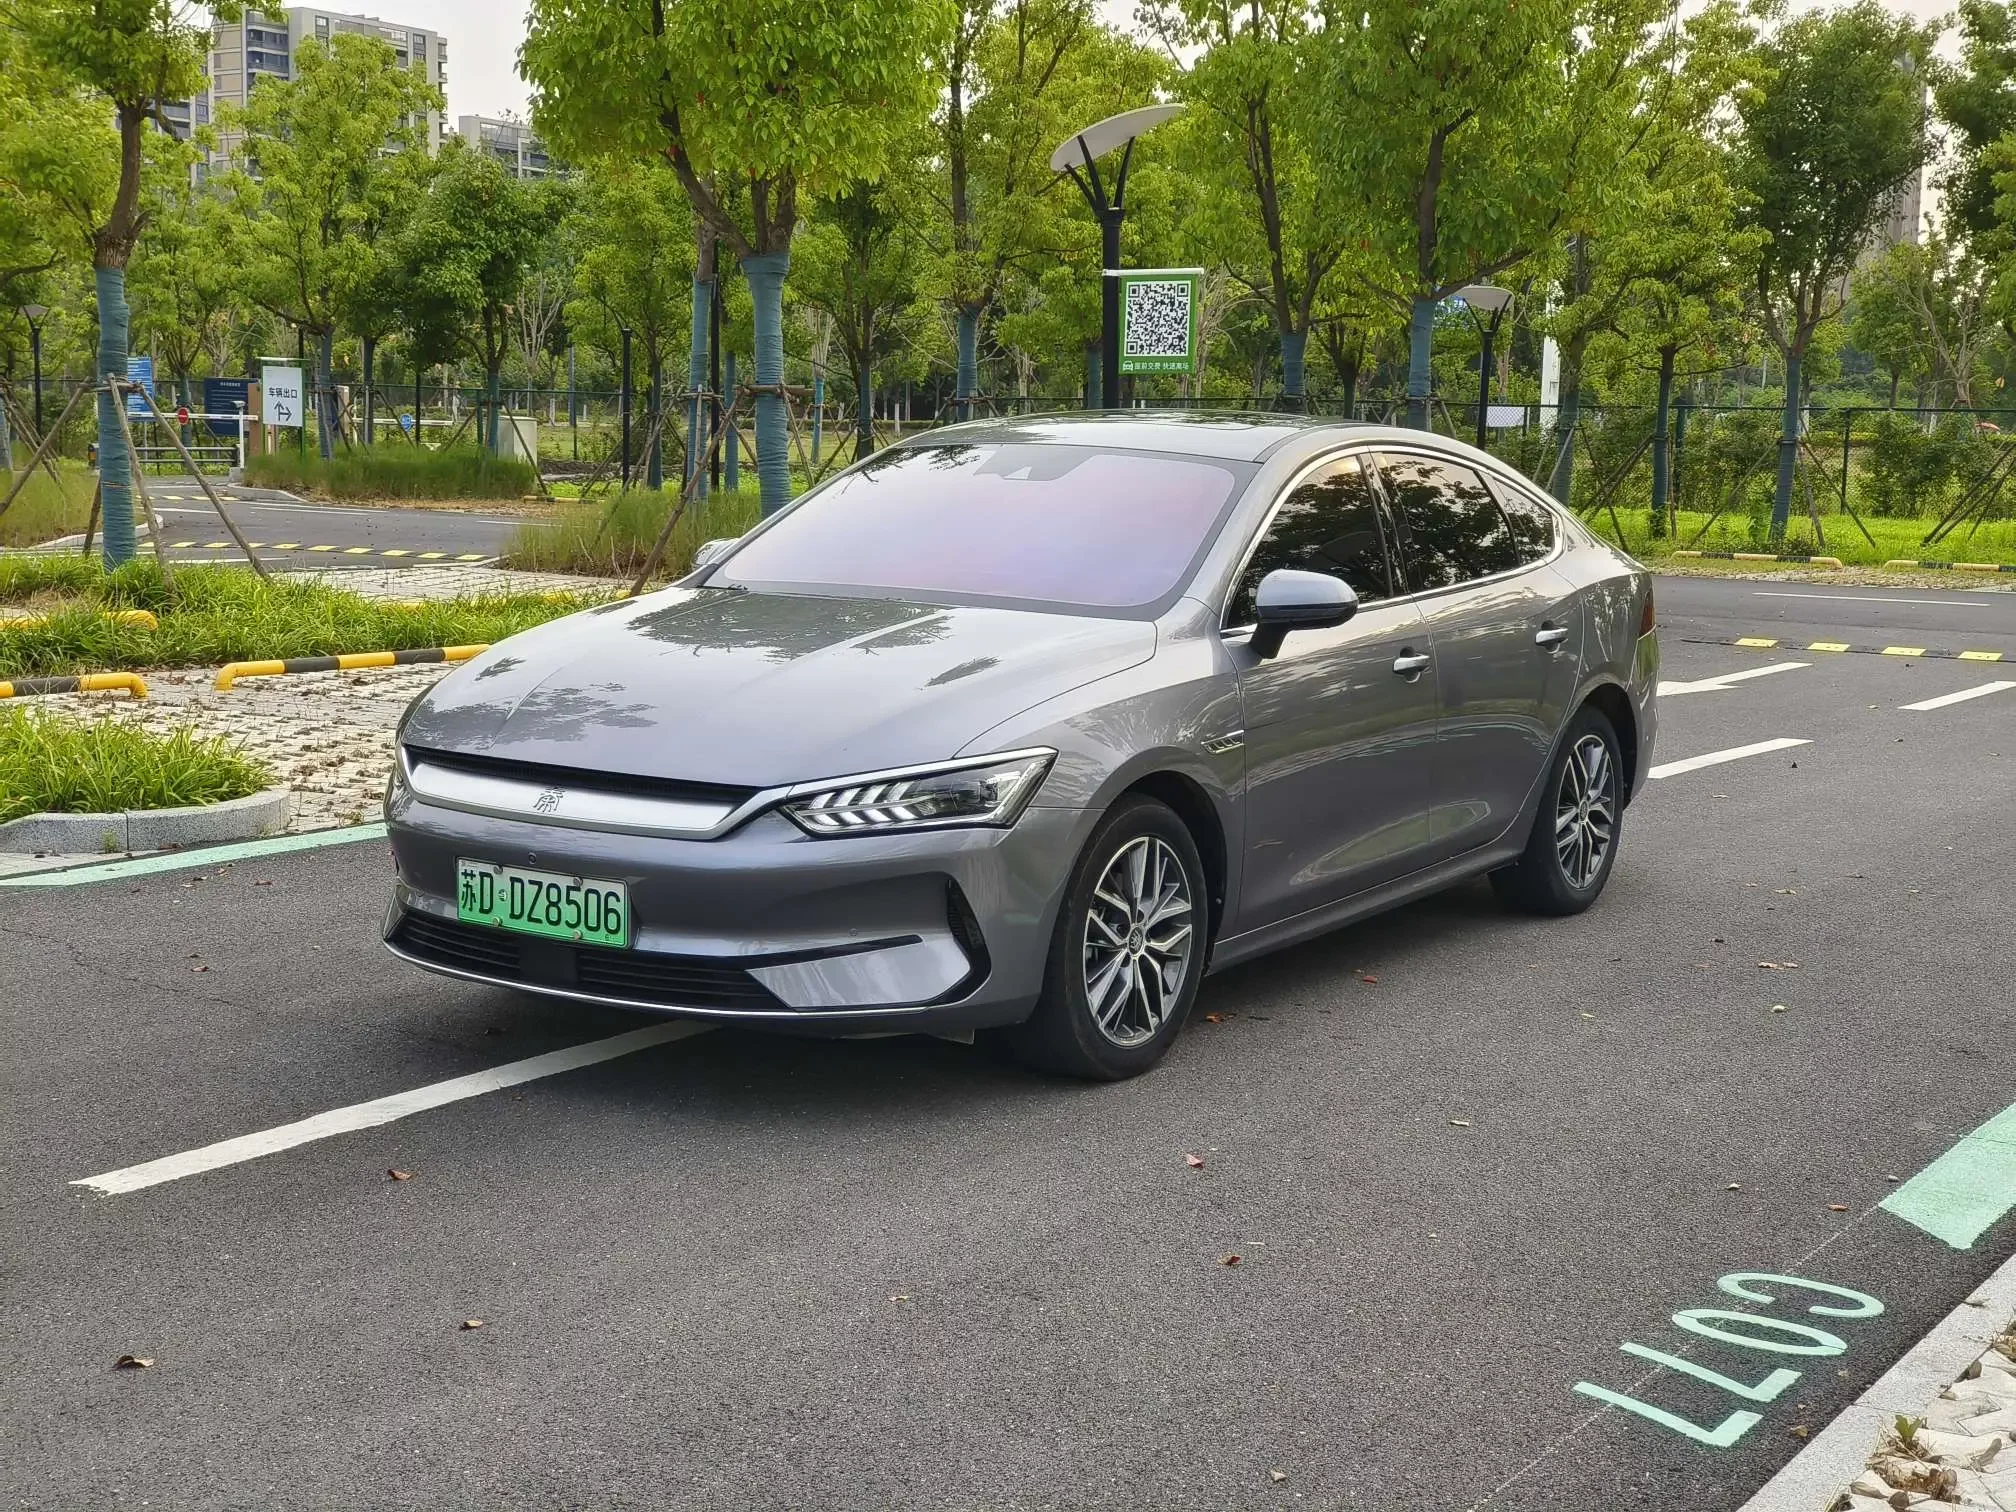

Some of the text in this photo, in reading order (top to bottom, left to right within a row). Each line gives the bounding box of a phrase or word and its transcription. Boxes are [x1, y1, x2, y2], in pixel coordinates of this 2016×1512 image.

[268, 387, 298, 399] 车辆出口
[1572, 1272, 1885, 1448] C077
